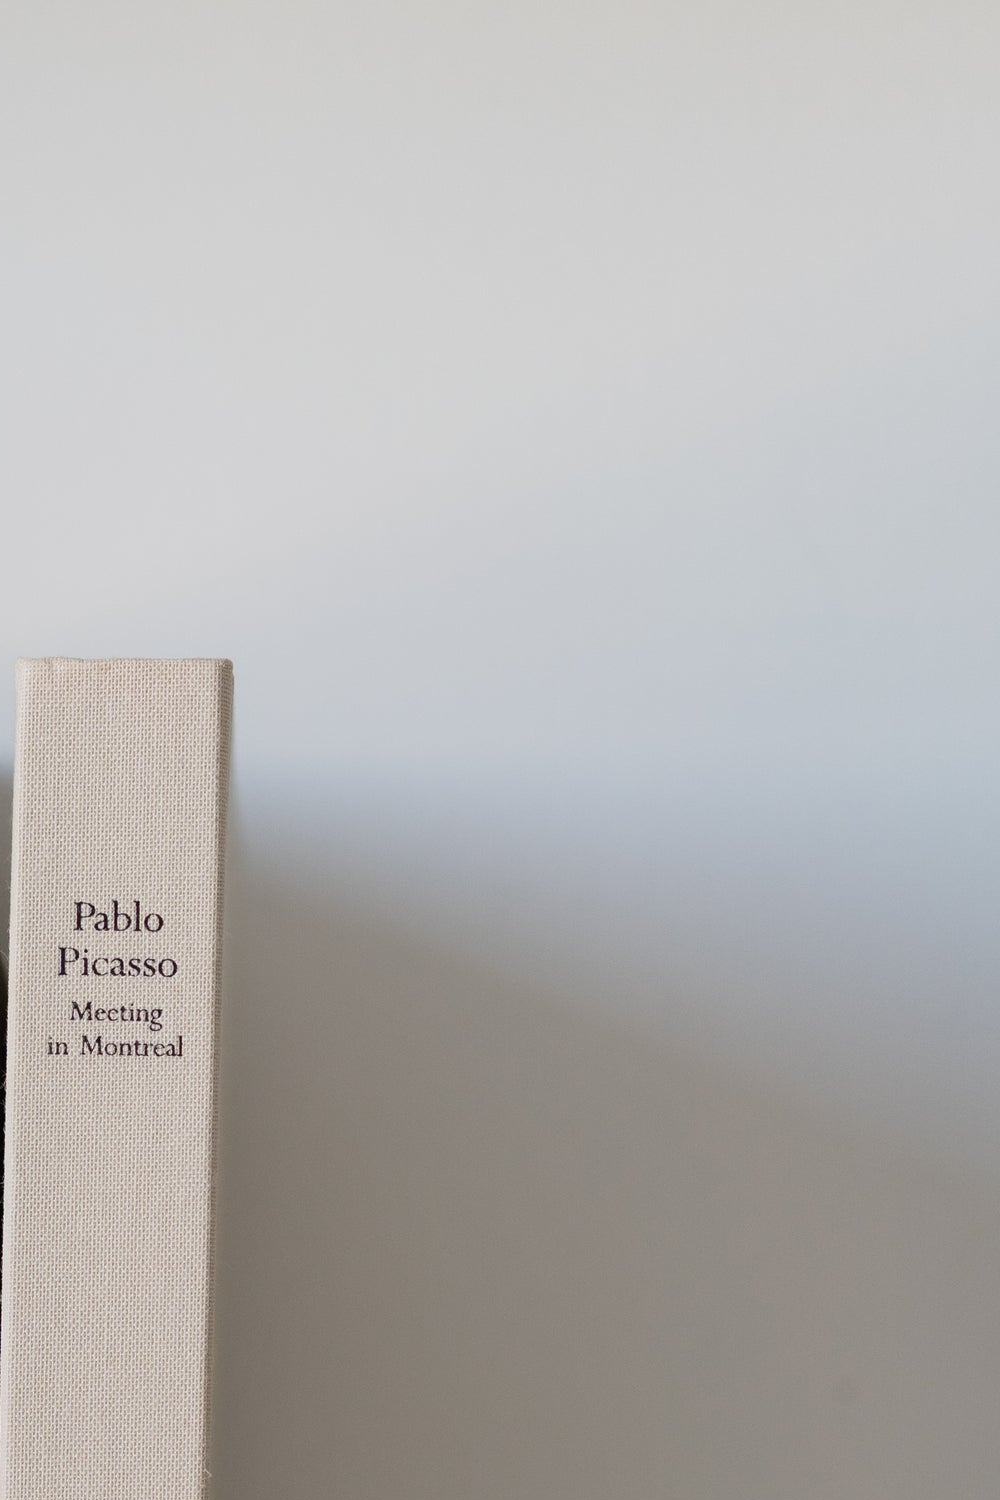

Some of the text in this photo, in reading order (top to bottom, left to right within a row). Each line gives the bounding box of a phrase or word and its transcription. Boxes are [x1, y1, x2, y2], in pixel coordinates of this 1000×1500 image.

[73, 900, 164, 932] Pablo
[58, 947, 178, 977] Picasso
[70, 1001, 163, 1031] Meeting
[47, 1035, 183, 1057] in Montreal
